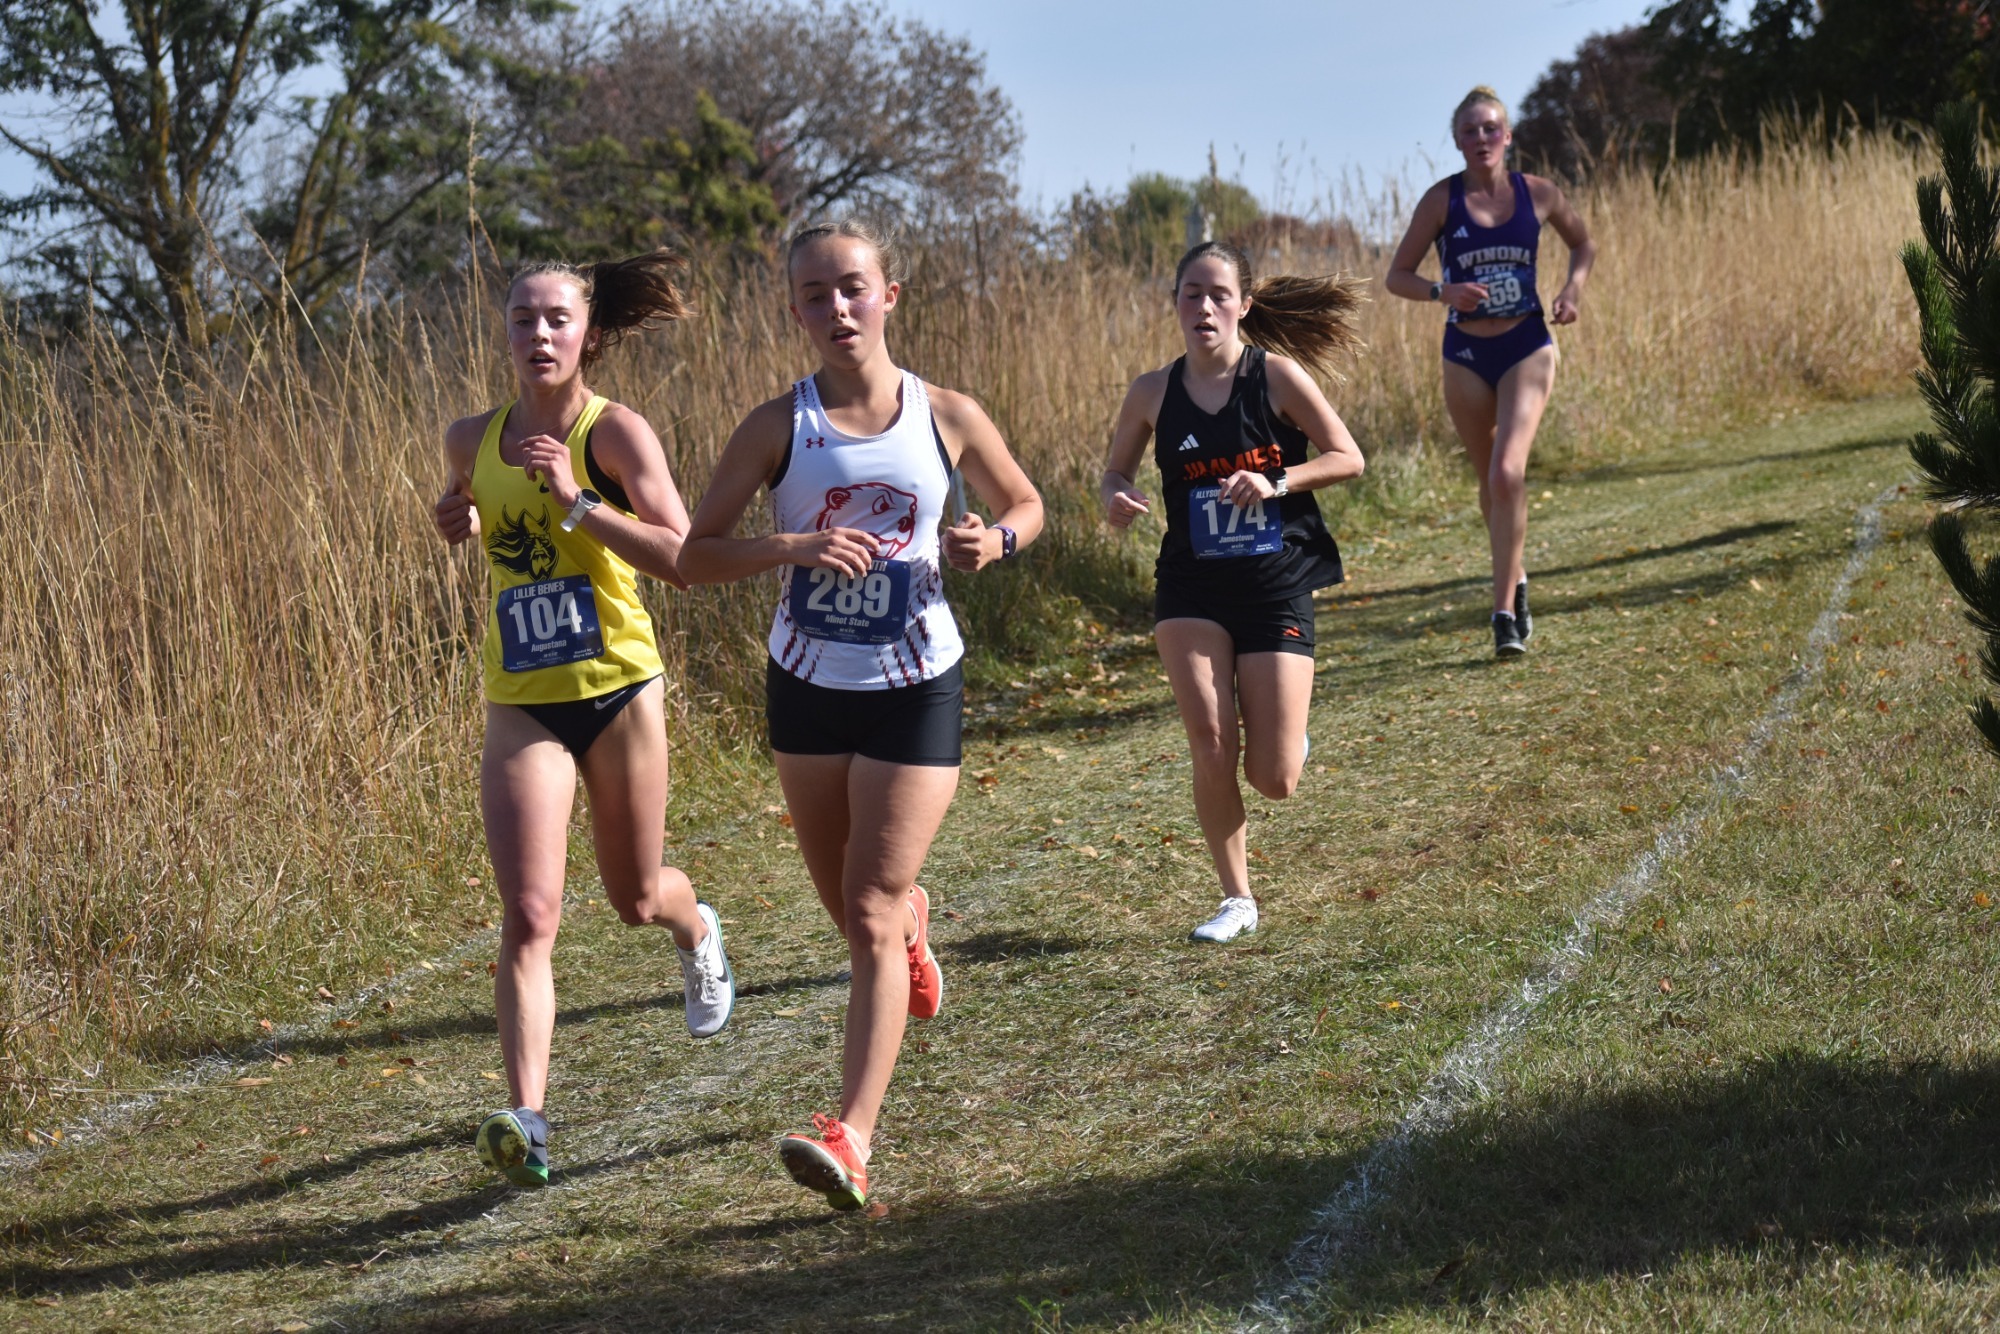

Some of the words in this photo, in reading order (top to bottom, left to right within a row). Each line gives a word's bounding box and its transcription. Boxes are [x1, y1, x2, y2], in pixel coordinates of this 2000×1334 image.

[1457, 246, 1531, 270] WINONA
[1474, 263, 1518, 276] STATE
[1195, 489, 1222, 499] ALLYSO
[1202, 498, 1268, 535] 174
[1219, 534, 1255, 544] Jamestown
[513, 585, 537, 600] LILLIE
[537, 580, 565, 595] BENES
[806, 567, 892, 618] 289
[508, 591, 583, 644] 104
[824, 614, 847, 627] Minot
[848, 617, 870, 627] State
[531, 639, 567, 653] Augustana
